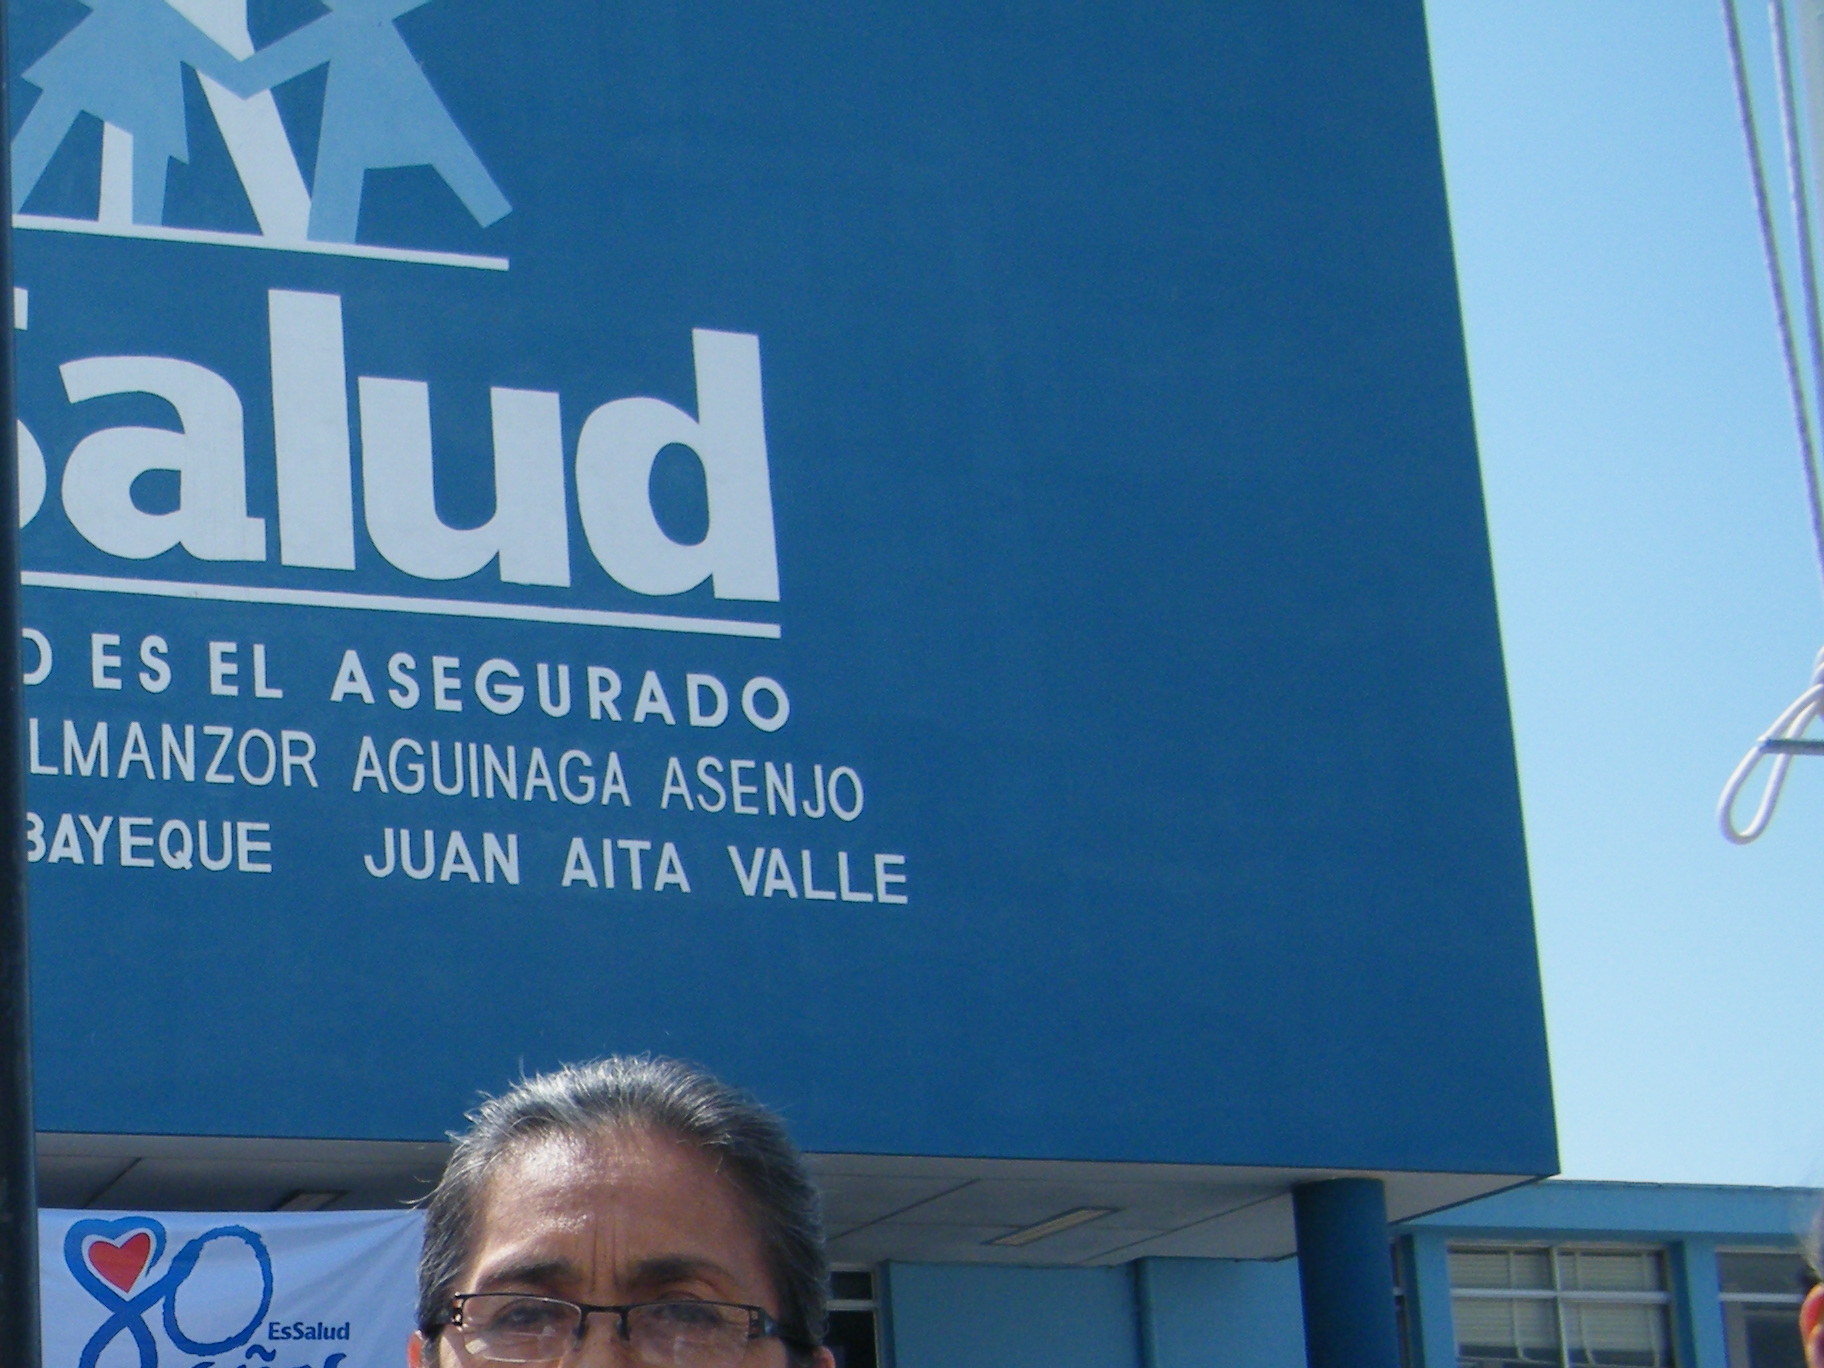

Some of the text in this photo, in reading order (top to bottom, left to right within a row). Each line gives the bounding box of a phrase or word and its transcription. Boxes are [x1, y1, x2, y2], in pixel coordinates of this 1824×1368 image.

[91, 632, 172, 693] ES
[208, 640, 283, 699] EL
[330, 649, 790, 732] ASEGURADO
[29, 717, 319, 788] LMANZOR
[352, 735, 631, 806] AGUINAGA
[661, 756, 864, 821] ASENJO
[364, 827, 519, 885] JUAN
[561, 837, 691, 893] AITA
[727, 845, 908, 904] VALLE
[268, 1321, 350, 1341] EsSalud
